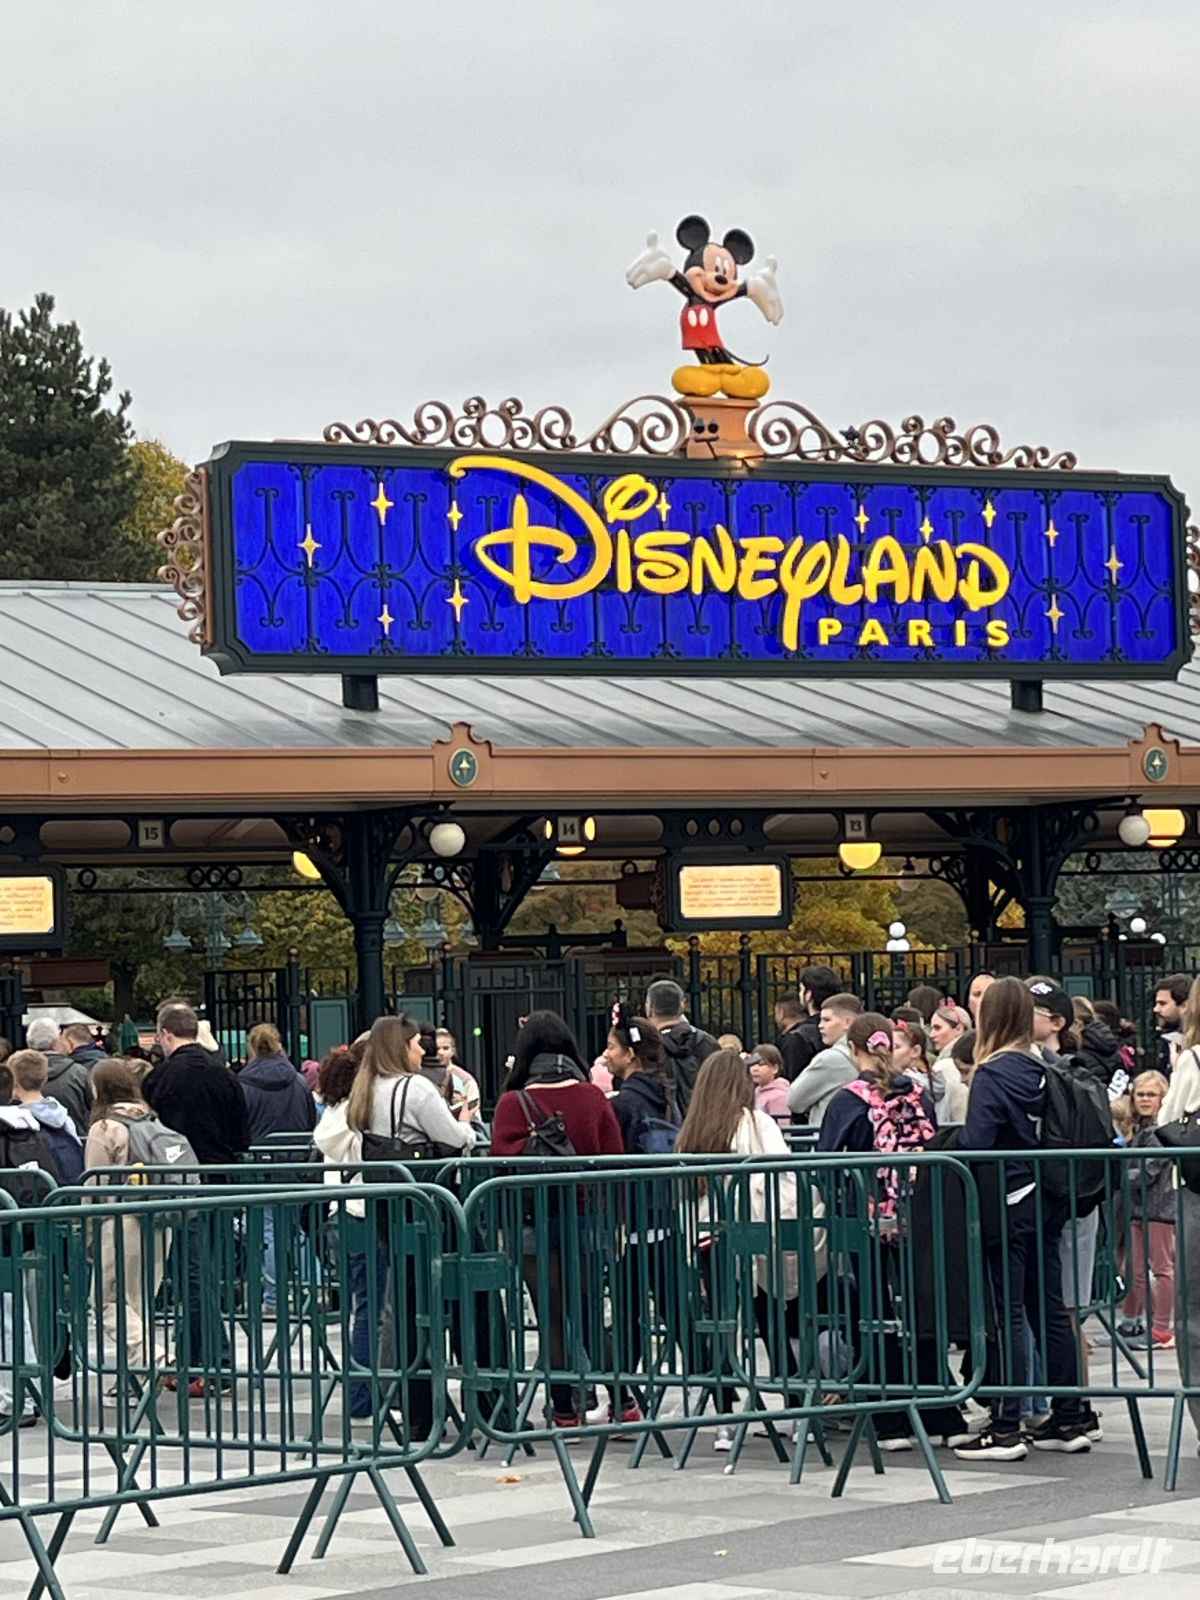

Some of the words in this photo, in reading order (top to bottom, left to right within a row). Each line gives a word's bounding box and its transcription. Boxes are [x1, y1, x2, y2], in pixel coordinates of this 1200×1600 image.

[818, 618, 1010, 647] PARIS
[562, 822, 576, 836] 14
[849, 820, 863, 832] 13
[143, 826, 159, 841] 15
